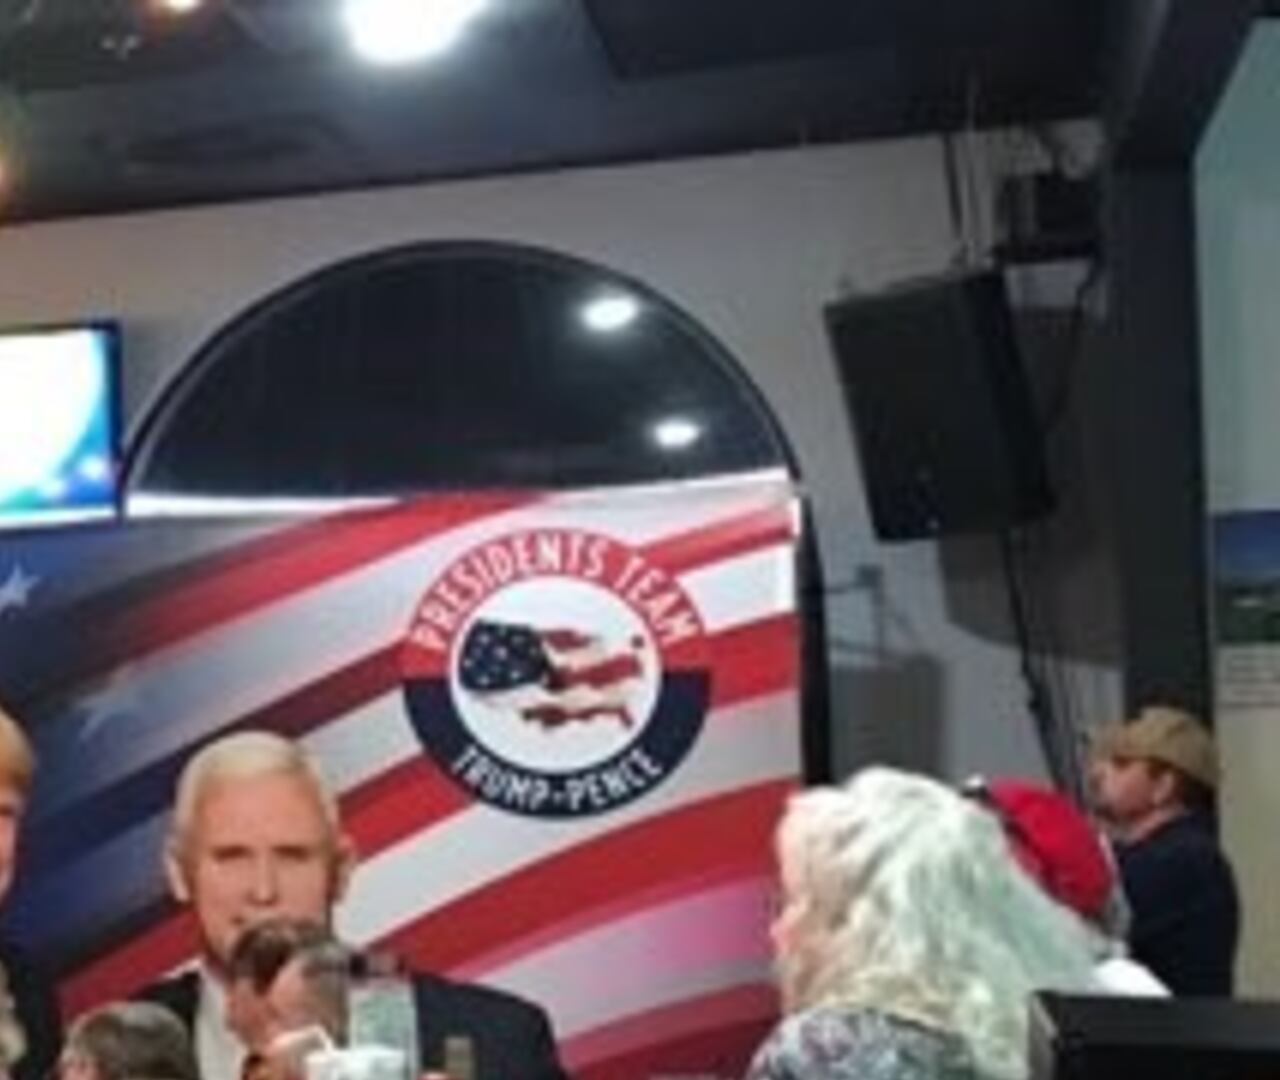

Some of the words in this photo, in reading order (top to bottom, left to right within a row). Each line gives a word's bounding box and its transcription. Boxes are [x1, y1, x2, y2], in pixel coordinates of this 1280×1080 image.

[410, 531, 608, 649] PRESIDENTS
[615, 555, 700, 648] TEAM
[450, 743, 662, 811] TRUMP-PENCE
